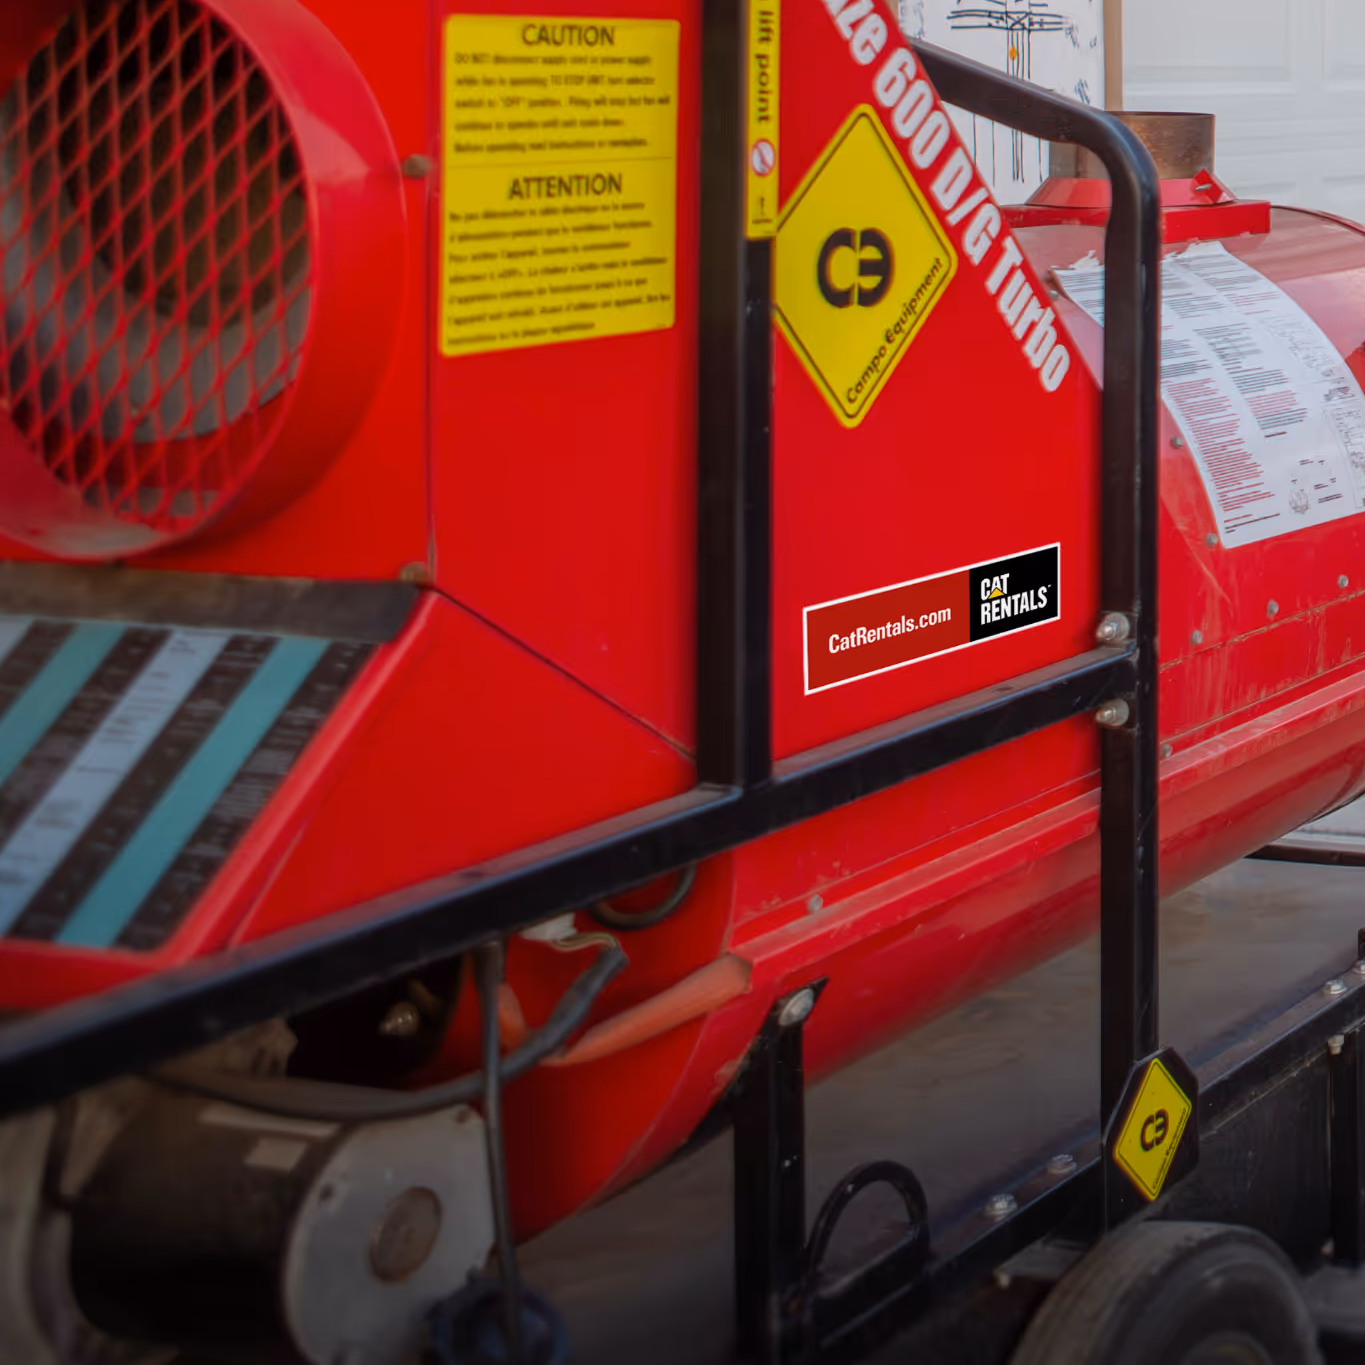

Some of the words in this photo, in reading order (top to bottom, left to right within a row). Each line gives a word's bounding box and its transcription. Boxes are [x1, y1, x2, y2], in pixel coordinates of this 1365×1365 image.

[522, 23, 616, 46] CAUTION
[758, 10, 775, 45] lift
[755, 53, 774, 125] point
[508, 172, 624, 200] ATTENTION
[873, 47, 951, 171] 600
[930, 165, 1003, 267] D/G
[984, 234, 1071, 394] Turbo
[846, 345, 888, 405] Campo
[883, 257, 944, 345] Equipment
[981, 573, 1010, 601] CAT
[981, 585, 1049, 626] RENTALS
[828, 607, 953, 654] CatRentals.com
